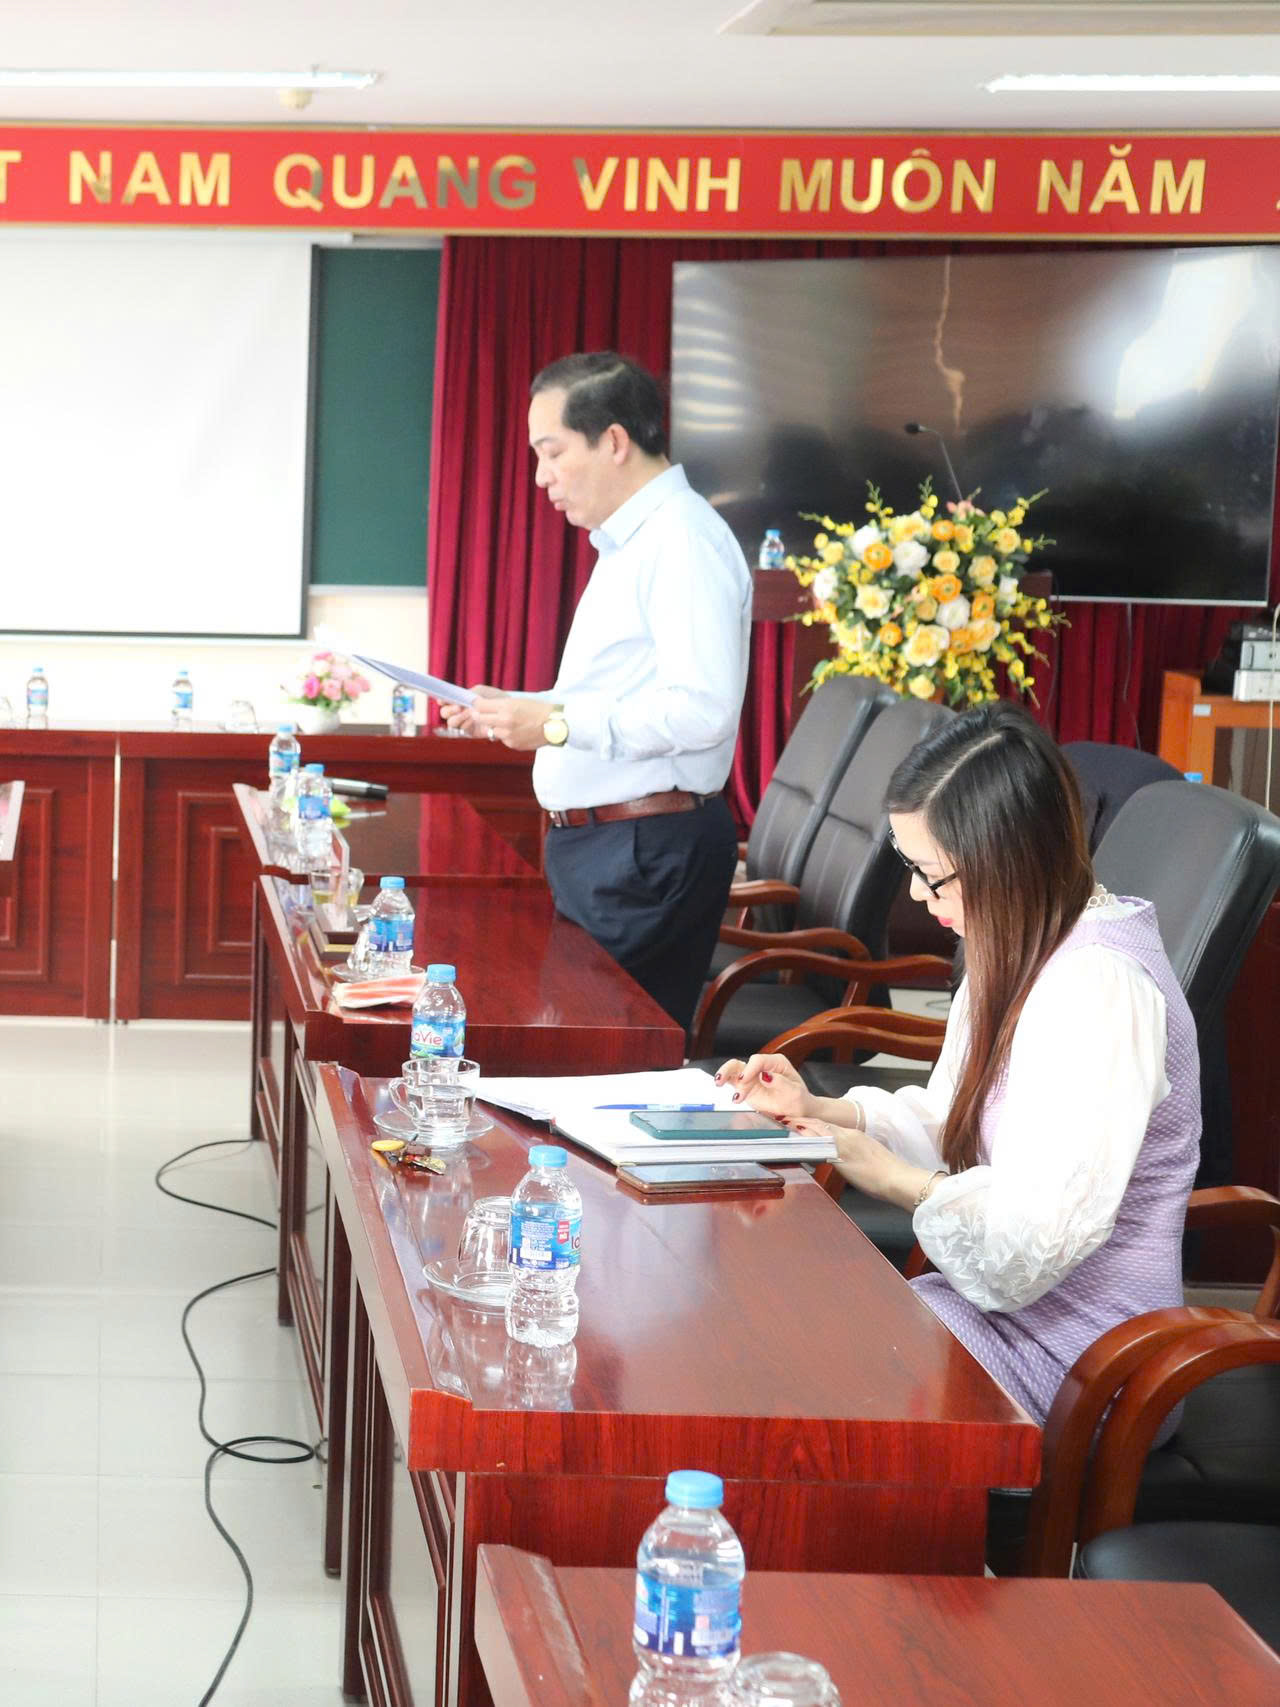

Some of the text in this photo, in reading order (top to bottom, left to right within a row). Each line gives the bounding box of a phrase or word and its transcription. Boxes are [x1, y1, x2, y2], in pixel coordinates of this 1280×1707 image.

[68, 151, 231, 207] NAM
[273, 153, 536, 213] QUANG
[573, 156, 742, 213] VINH
[778, 147, 997, 214] MUÔN
[1036, 143, 1206, 215] NĂM
